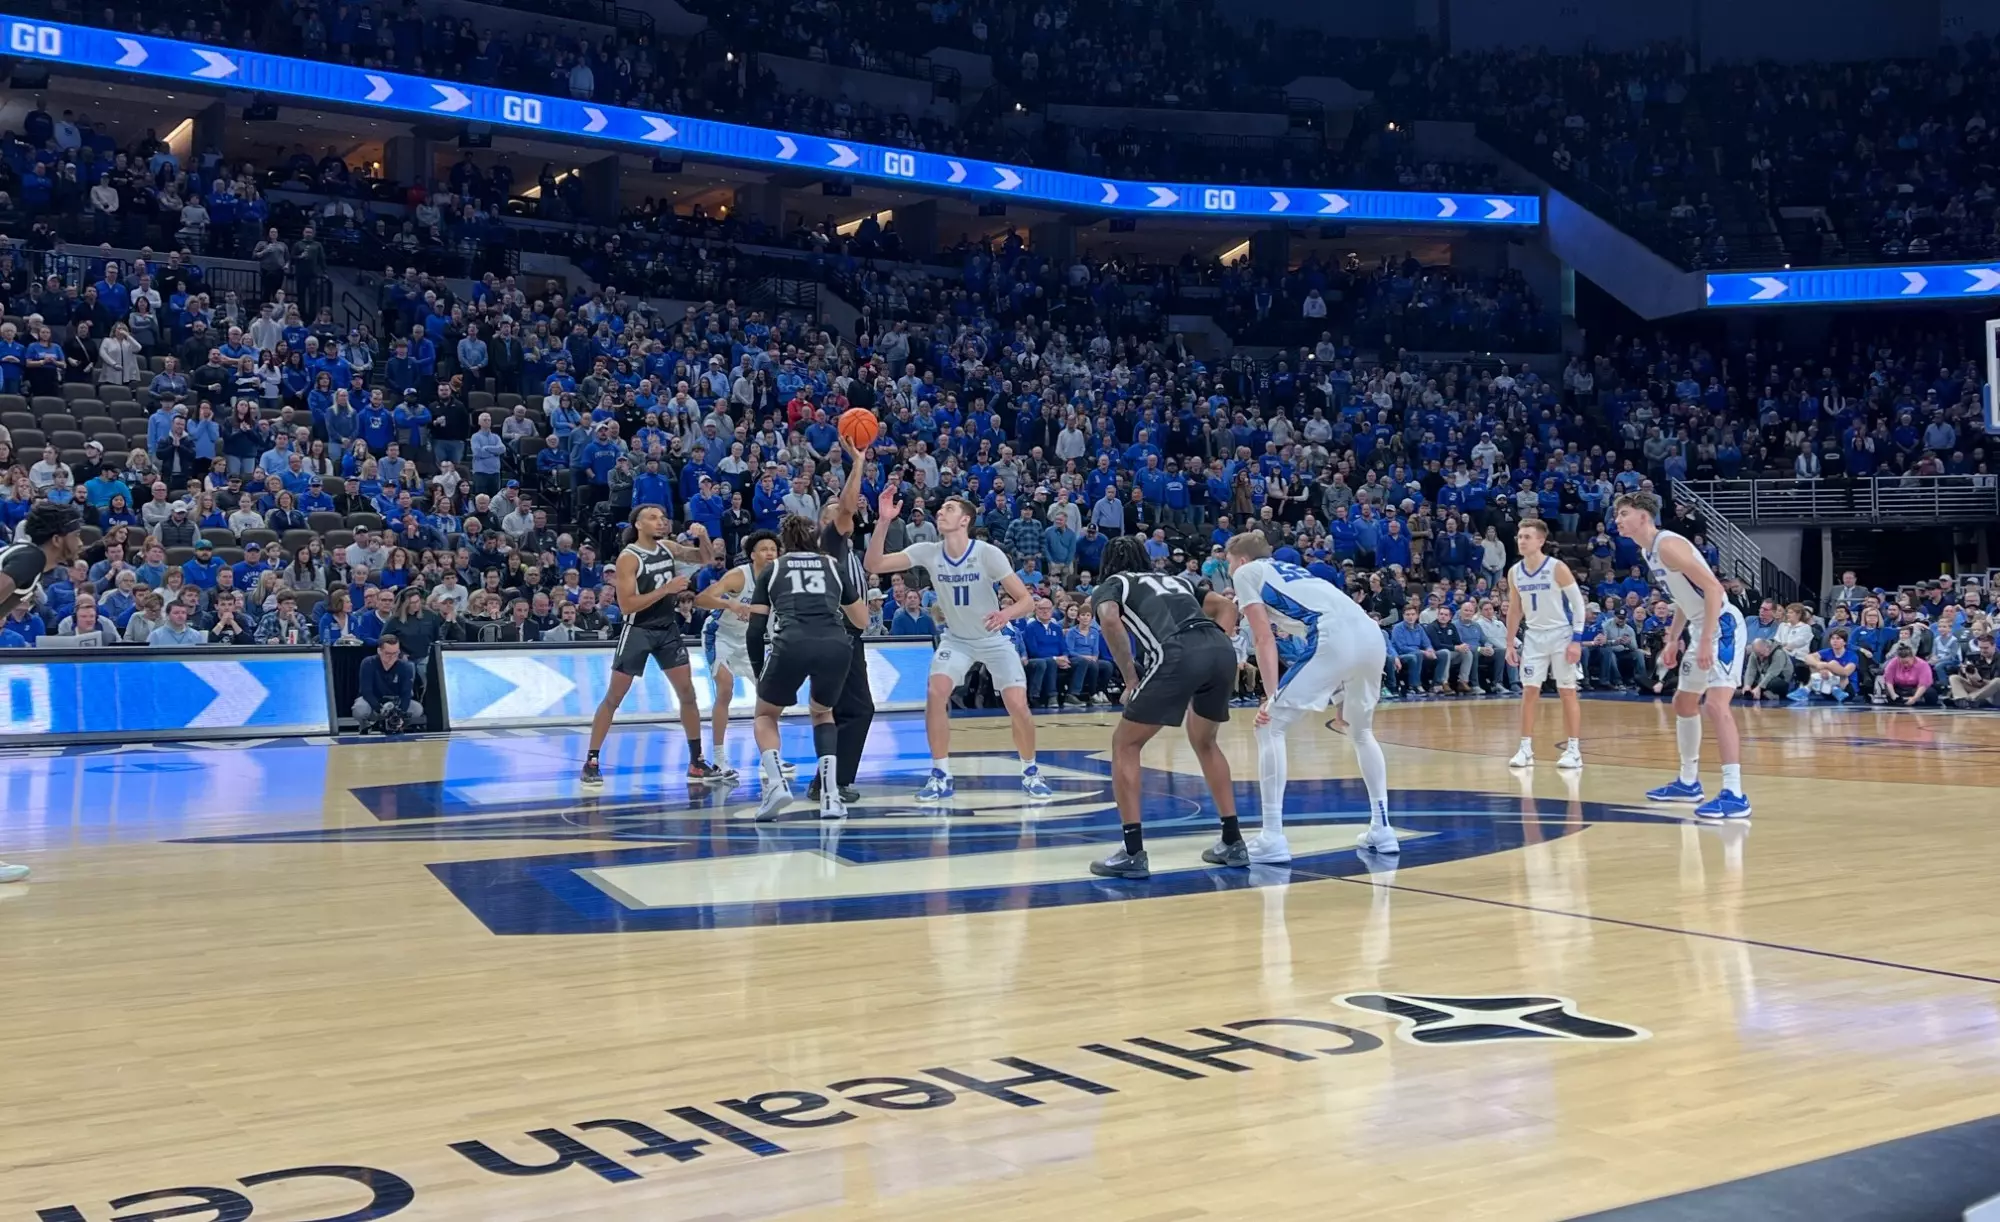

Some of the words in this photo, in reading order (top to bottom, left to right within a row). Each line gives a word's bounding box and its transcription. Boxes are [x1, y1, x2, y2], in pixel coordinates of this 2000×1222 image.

[12, 22, 60, 56] GO
[503, 95, 542, 124] GO
[884, 151, 915, 177] GO
[1204, 189, 1235, 210] GO
[786, 559, 822, 568] ODURO
[784, 569, 826, 594] 13
[937, 572, 980, 583] CREIGHTON
[952, 585, 970, 606] 11
[1529, 593, 1537, 612] 1
[1080, 1018, 1384, 1081] CHI
[446, 1056, 1116, 1184] Health
